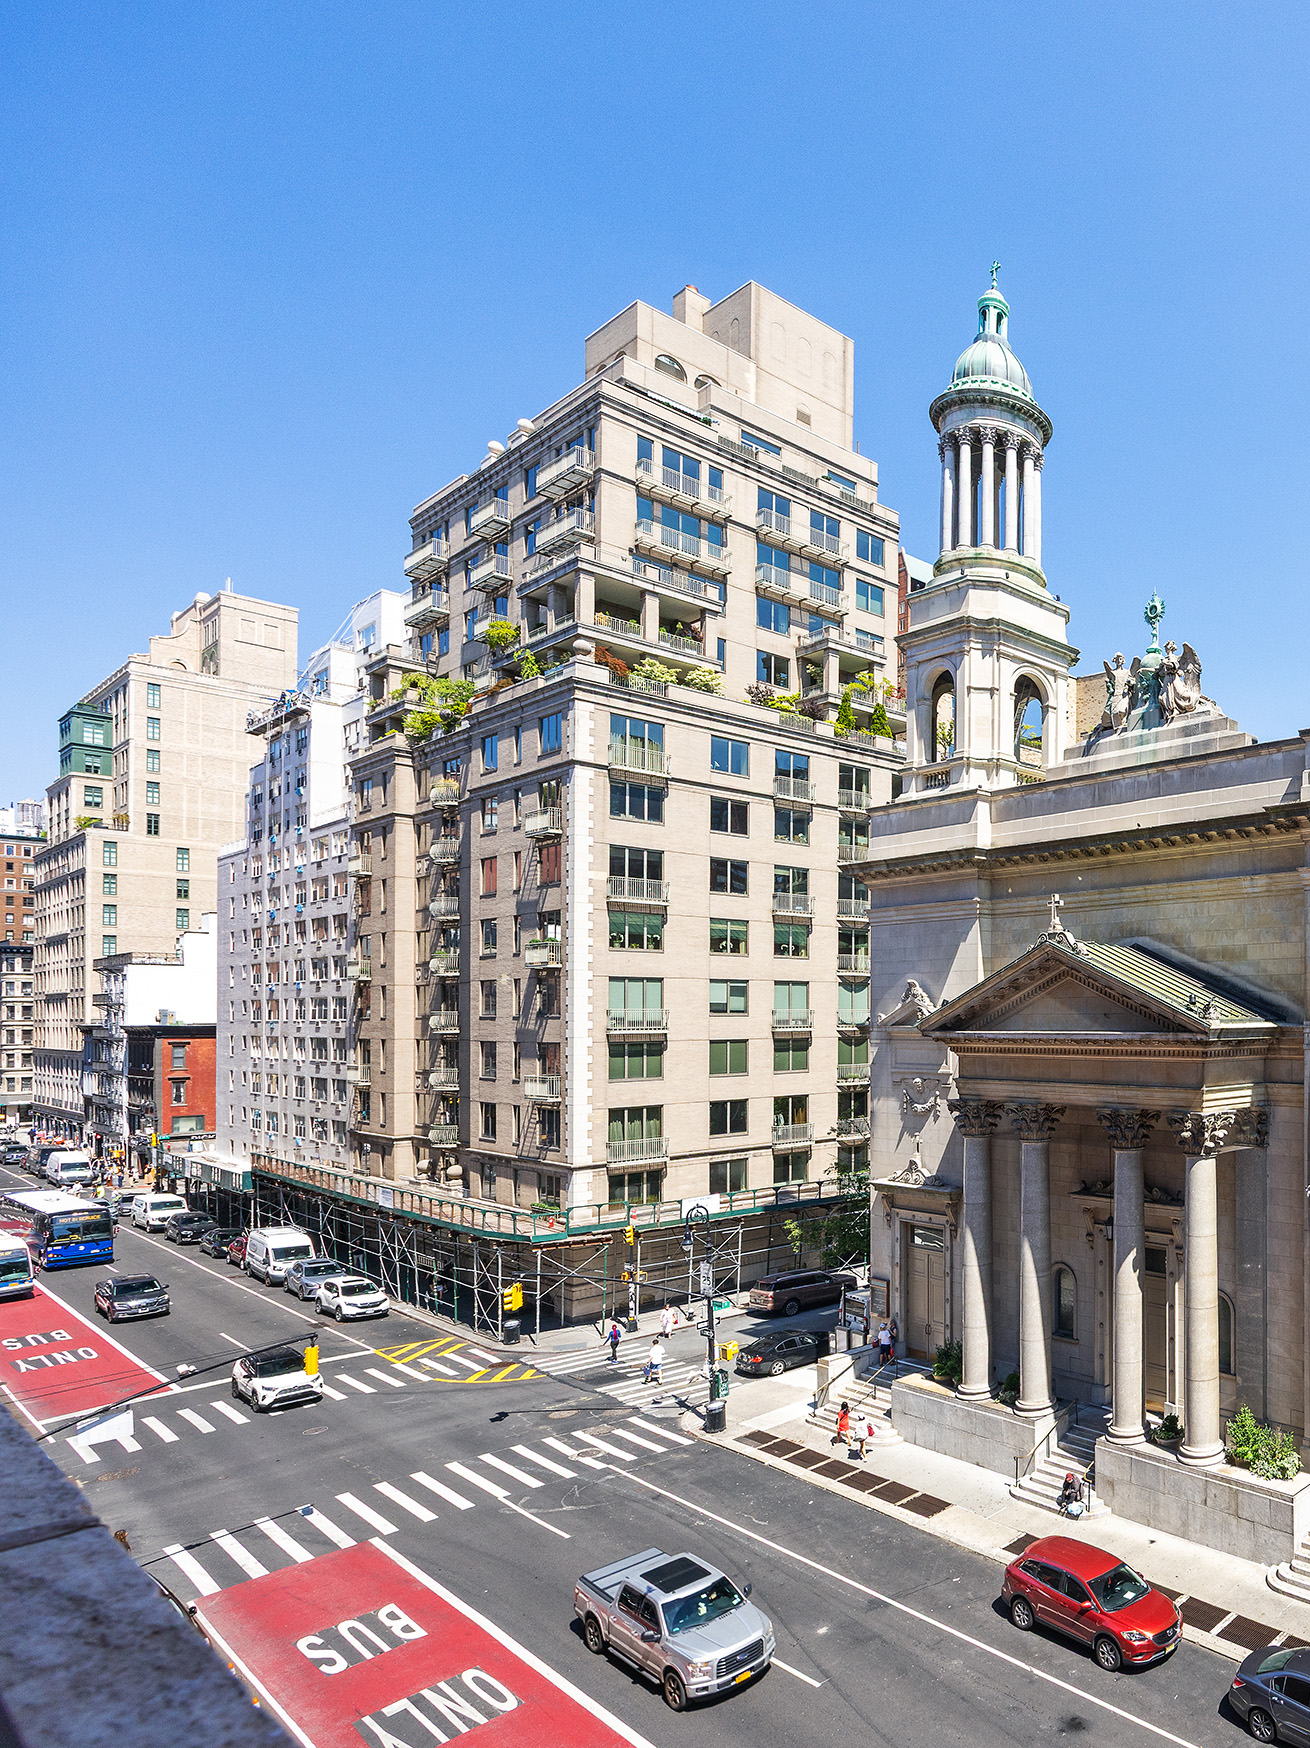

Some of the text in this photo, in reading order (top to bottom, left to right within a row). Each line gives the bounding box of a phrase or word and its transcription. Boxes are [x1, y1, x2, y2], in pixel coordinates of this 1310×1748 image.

[702, 1275, 711, 1286] 25
[1, 1329, 73, 1350] BUS
[15, 1347, 99, 1373] ONLY
[296, 1602, 429, 1675] BUS
[361, 1668, 519, 1748] ONLY
